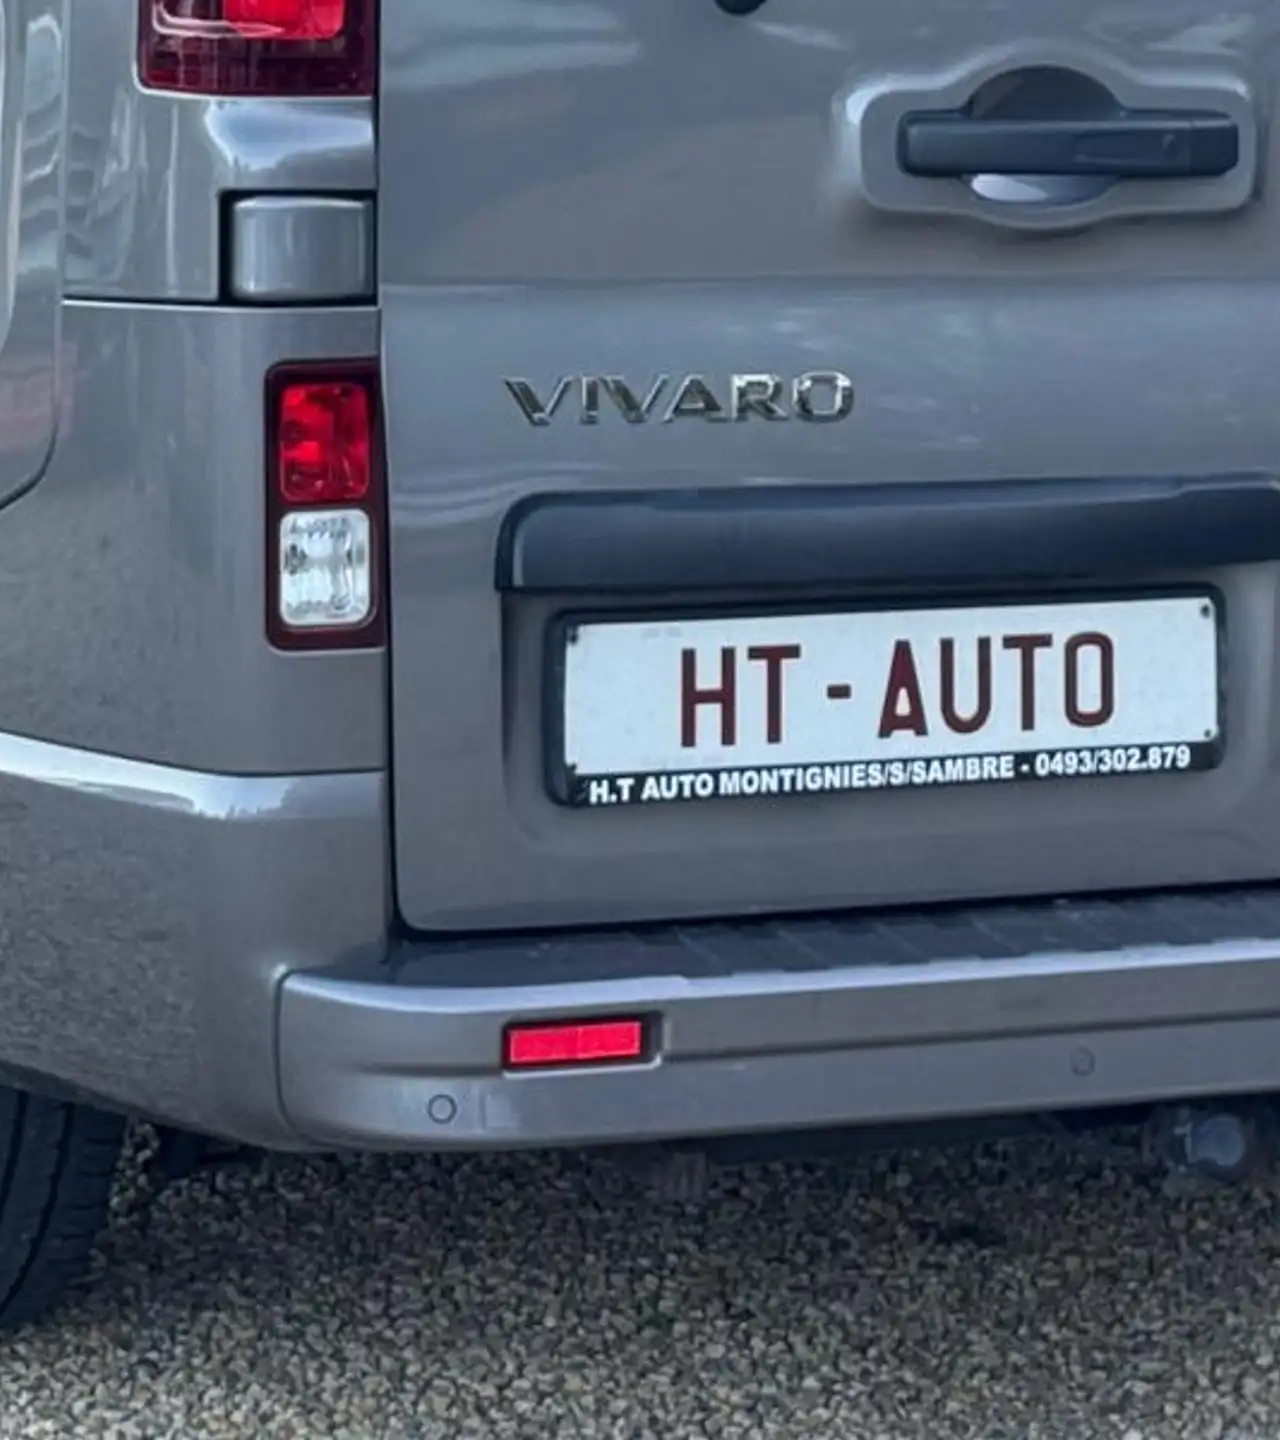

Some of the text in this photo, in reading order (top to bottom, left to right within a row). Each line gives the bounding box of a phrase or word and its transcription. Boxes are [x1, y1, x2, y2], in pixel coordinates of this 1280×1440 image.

[503, 371, 855, 426] VIVARO
[681, 644, 801, 748] HT
[878, 631, 1114, 739] AUTO
[589, 779, 634, 804] H.T
[641, 773, 714, 801] AUTO
[718, 754, 1016, 796] MONTIGNIES/S/SAMBRE
[1034, 744, 1192, 777] 0493/302.879
